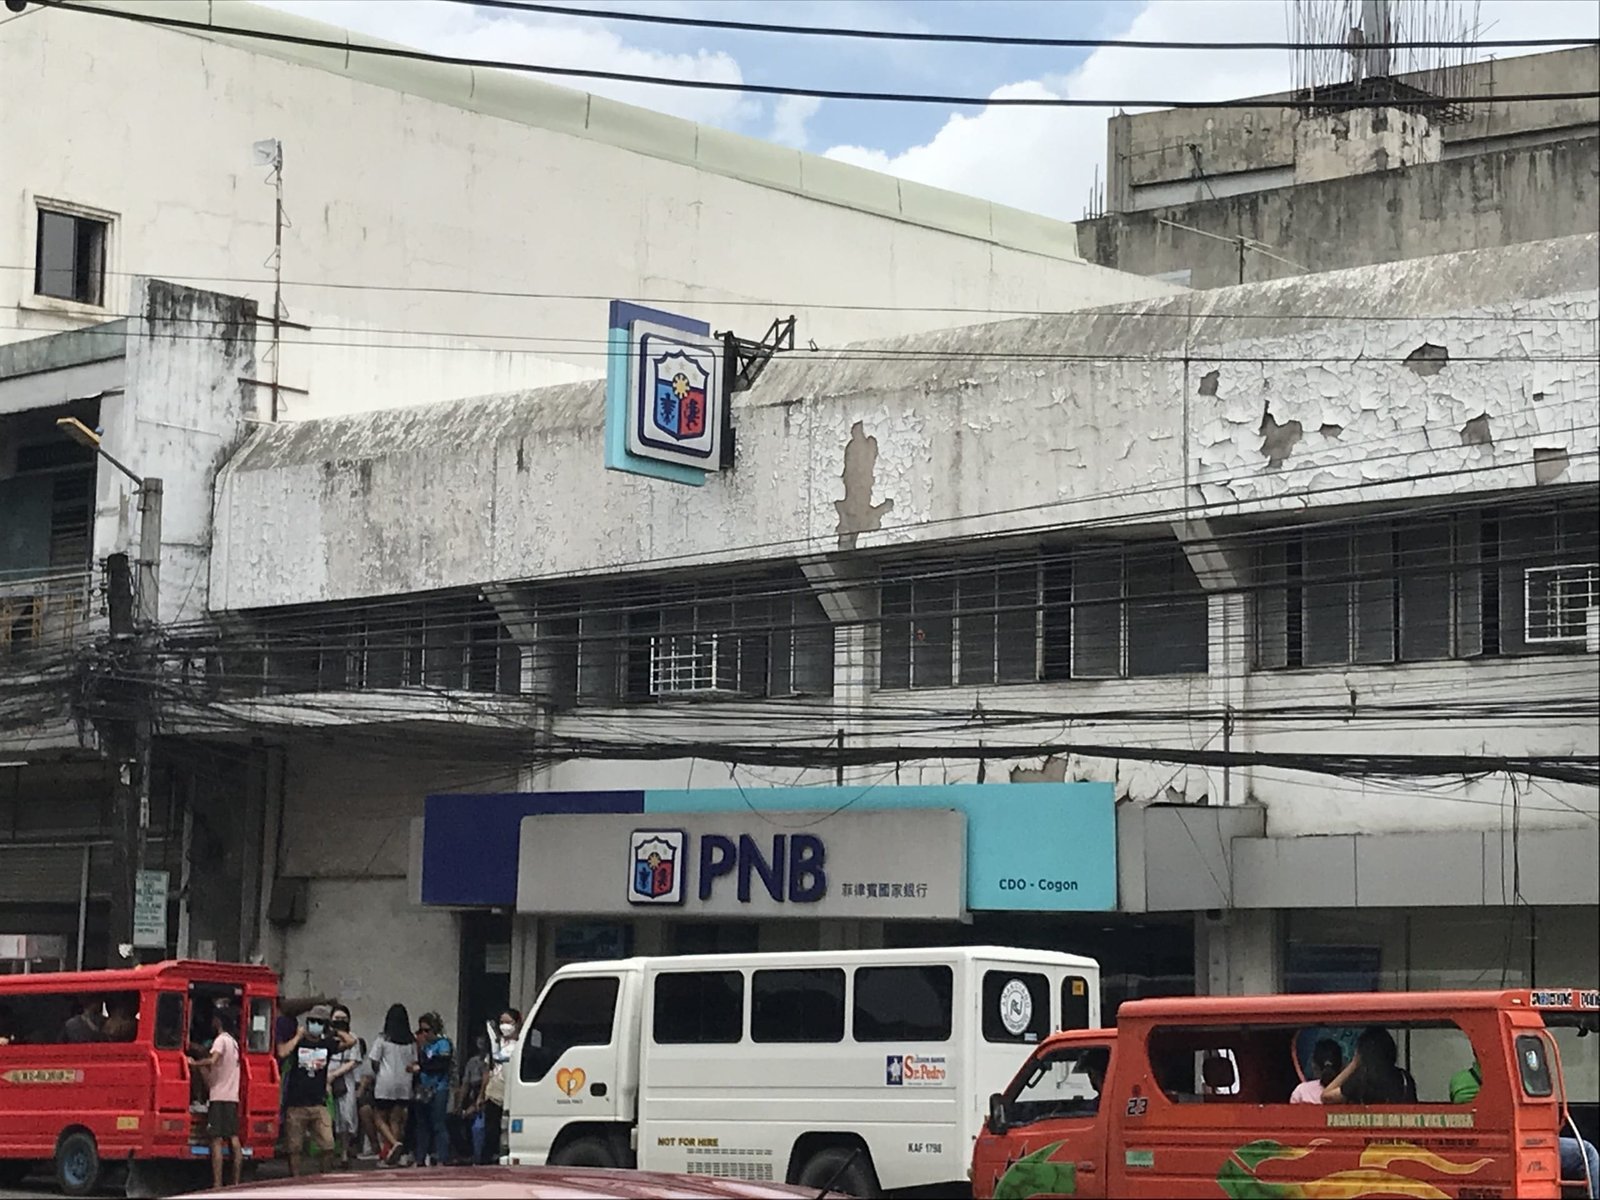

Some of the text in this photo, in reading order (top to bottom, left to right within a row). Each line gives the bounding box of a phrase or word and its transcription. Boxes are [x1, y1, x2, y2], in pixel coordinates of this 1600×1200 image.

[698, 834, 827, 903] PNB
[999, 879, 1026, 890] CDO
[1038, 879, 1078, 892] Cogon
[1126, 1097, 1148, 1115] 23
[657, 1137, 719, 1147] NOT FOR HIRE
